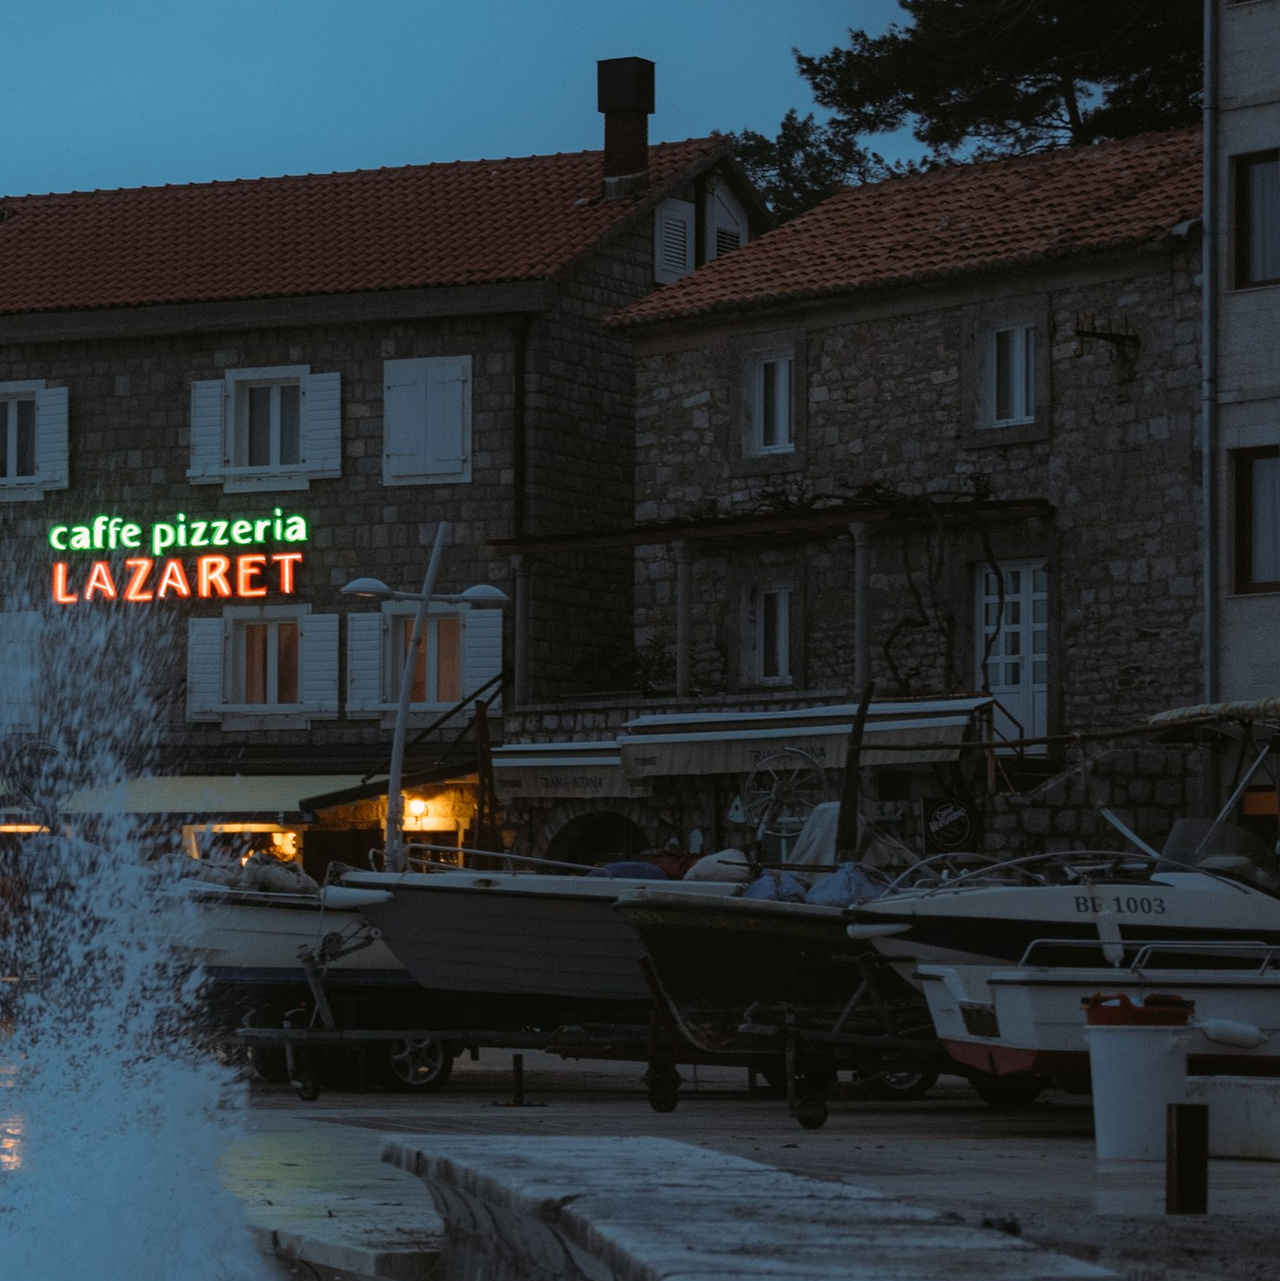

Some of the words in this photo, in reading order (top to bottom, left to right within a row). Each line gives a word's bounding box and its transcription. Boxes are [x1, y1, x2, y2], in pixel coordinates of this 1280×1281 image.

[49, 516, 142, 550] caffe
[151, 508, 308, 556] pizzeria
[52, 552, 303, 604] LAZARET
[1113, 896, 1166, 915] 1003
